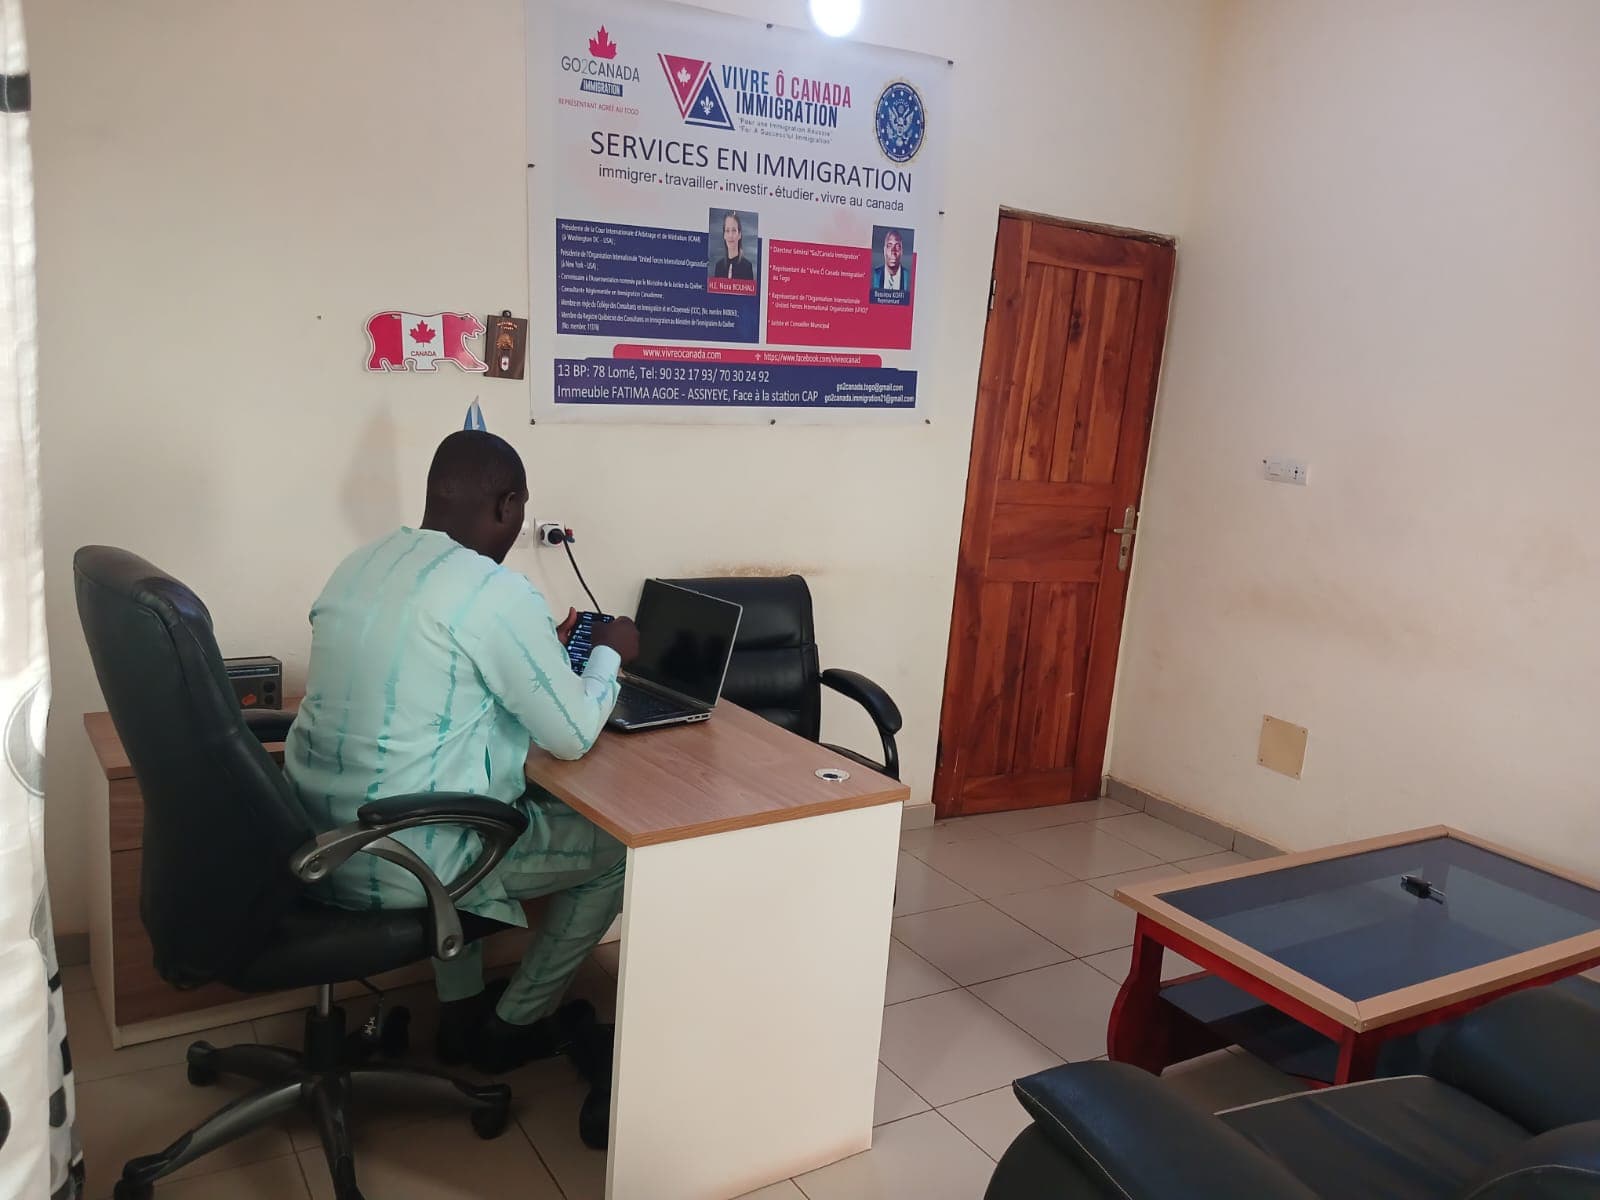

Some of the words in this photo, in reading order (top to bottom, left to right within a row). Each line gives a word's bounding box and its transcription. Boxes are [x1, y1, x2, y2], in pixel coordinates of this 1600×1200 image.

[560, 56, 640, 82] GO2CANADA
[582, 79, 622, 96] IMMIGRATION
[722, 64, 770, 95] VIVRE
[775, 69, 785, 97] Ô
[791, 76, 852, 109] CANADA
[736, 91, 838, 128] IMMIGRATION
[590, 131, 709, 169] SERVICES
[717, 147, 748, 173] EN
[757, 152, 912, 194] IMMIGRATION
[820, 192, 847, 206] vivre
[850, 196, 864, 208] au
[866, 198, 905, 213] canada
[642, 348, 722, 360] www.vivreocanada.com
[557, 364, 571, 377] 13
[573, 365, 590, 377] BP:
[592, 365, 606, 378] 78
[608, 366, 638, 380] Lomé,
[640, 366, 658, 380] Tel:
[660, 367, 672, 380] 90
[674, 367, 686, 381] 32
[688, 368, 699, 381] 17
[719, 369, 731, 382] 70
[732, 370, 744, 382] 30
[746, 370, 757, 382] 24
[758, 371, 770, 383] 92
[557, 385, 609, 399] Immeuble
[611, 387, 650, 400] FATIMA
[652, 387, 680, 400] AGOE
[688, 388, 731, 402] ASSIYEYE,
[733, 389, 754, 401] Face
[755, 389, 760, 401] à
[762, 389, 770, 401] la
[772, 389, 800, 402] station
[801, 390, 819, 402] CAP
